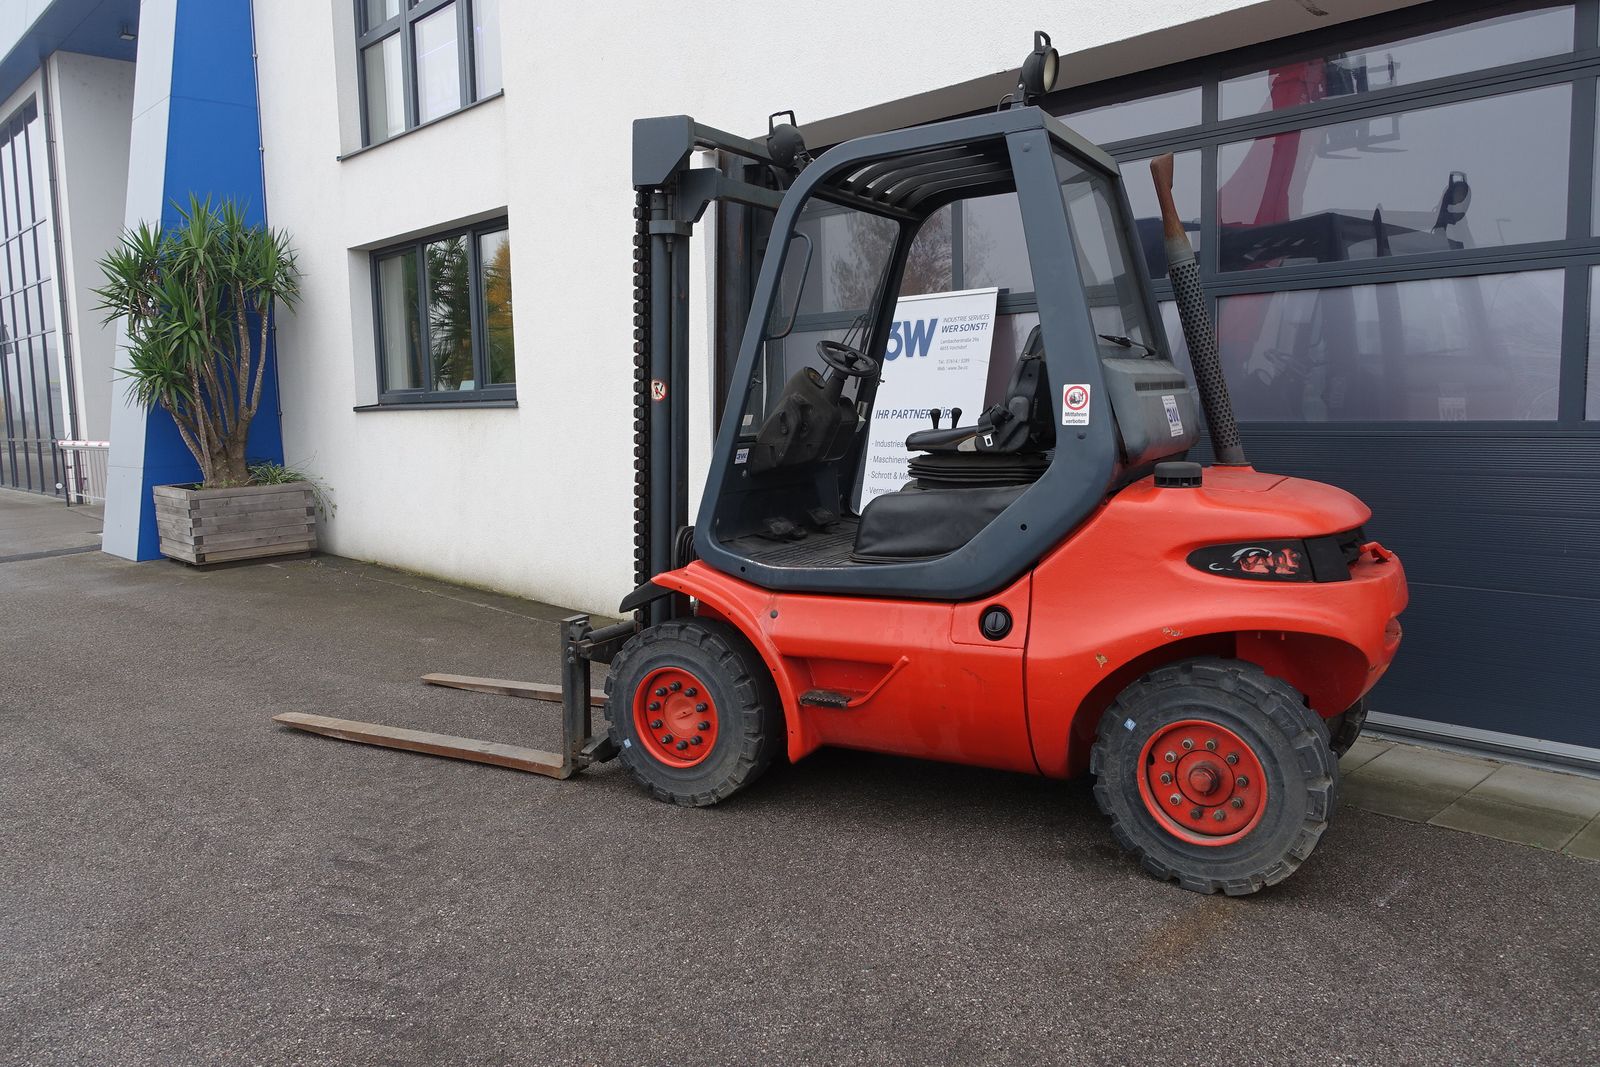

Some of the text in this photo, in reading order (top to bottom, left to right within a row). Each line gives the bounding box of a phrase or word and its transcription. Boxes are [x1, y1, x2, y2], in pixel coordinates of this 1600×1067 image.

[968, 313, 990, 321] SERVICES
[941, 322, 988, 333] WER SONST!
[875, 409, 889, 419] IHR
[891, 409, 931, 419] PARTNER
[870, 470, 892, 479] Schrott
[893, 472, 898, 480] &
